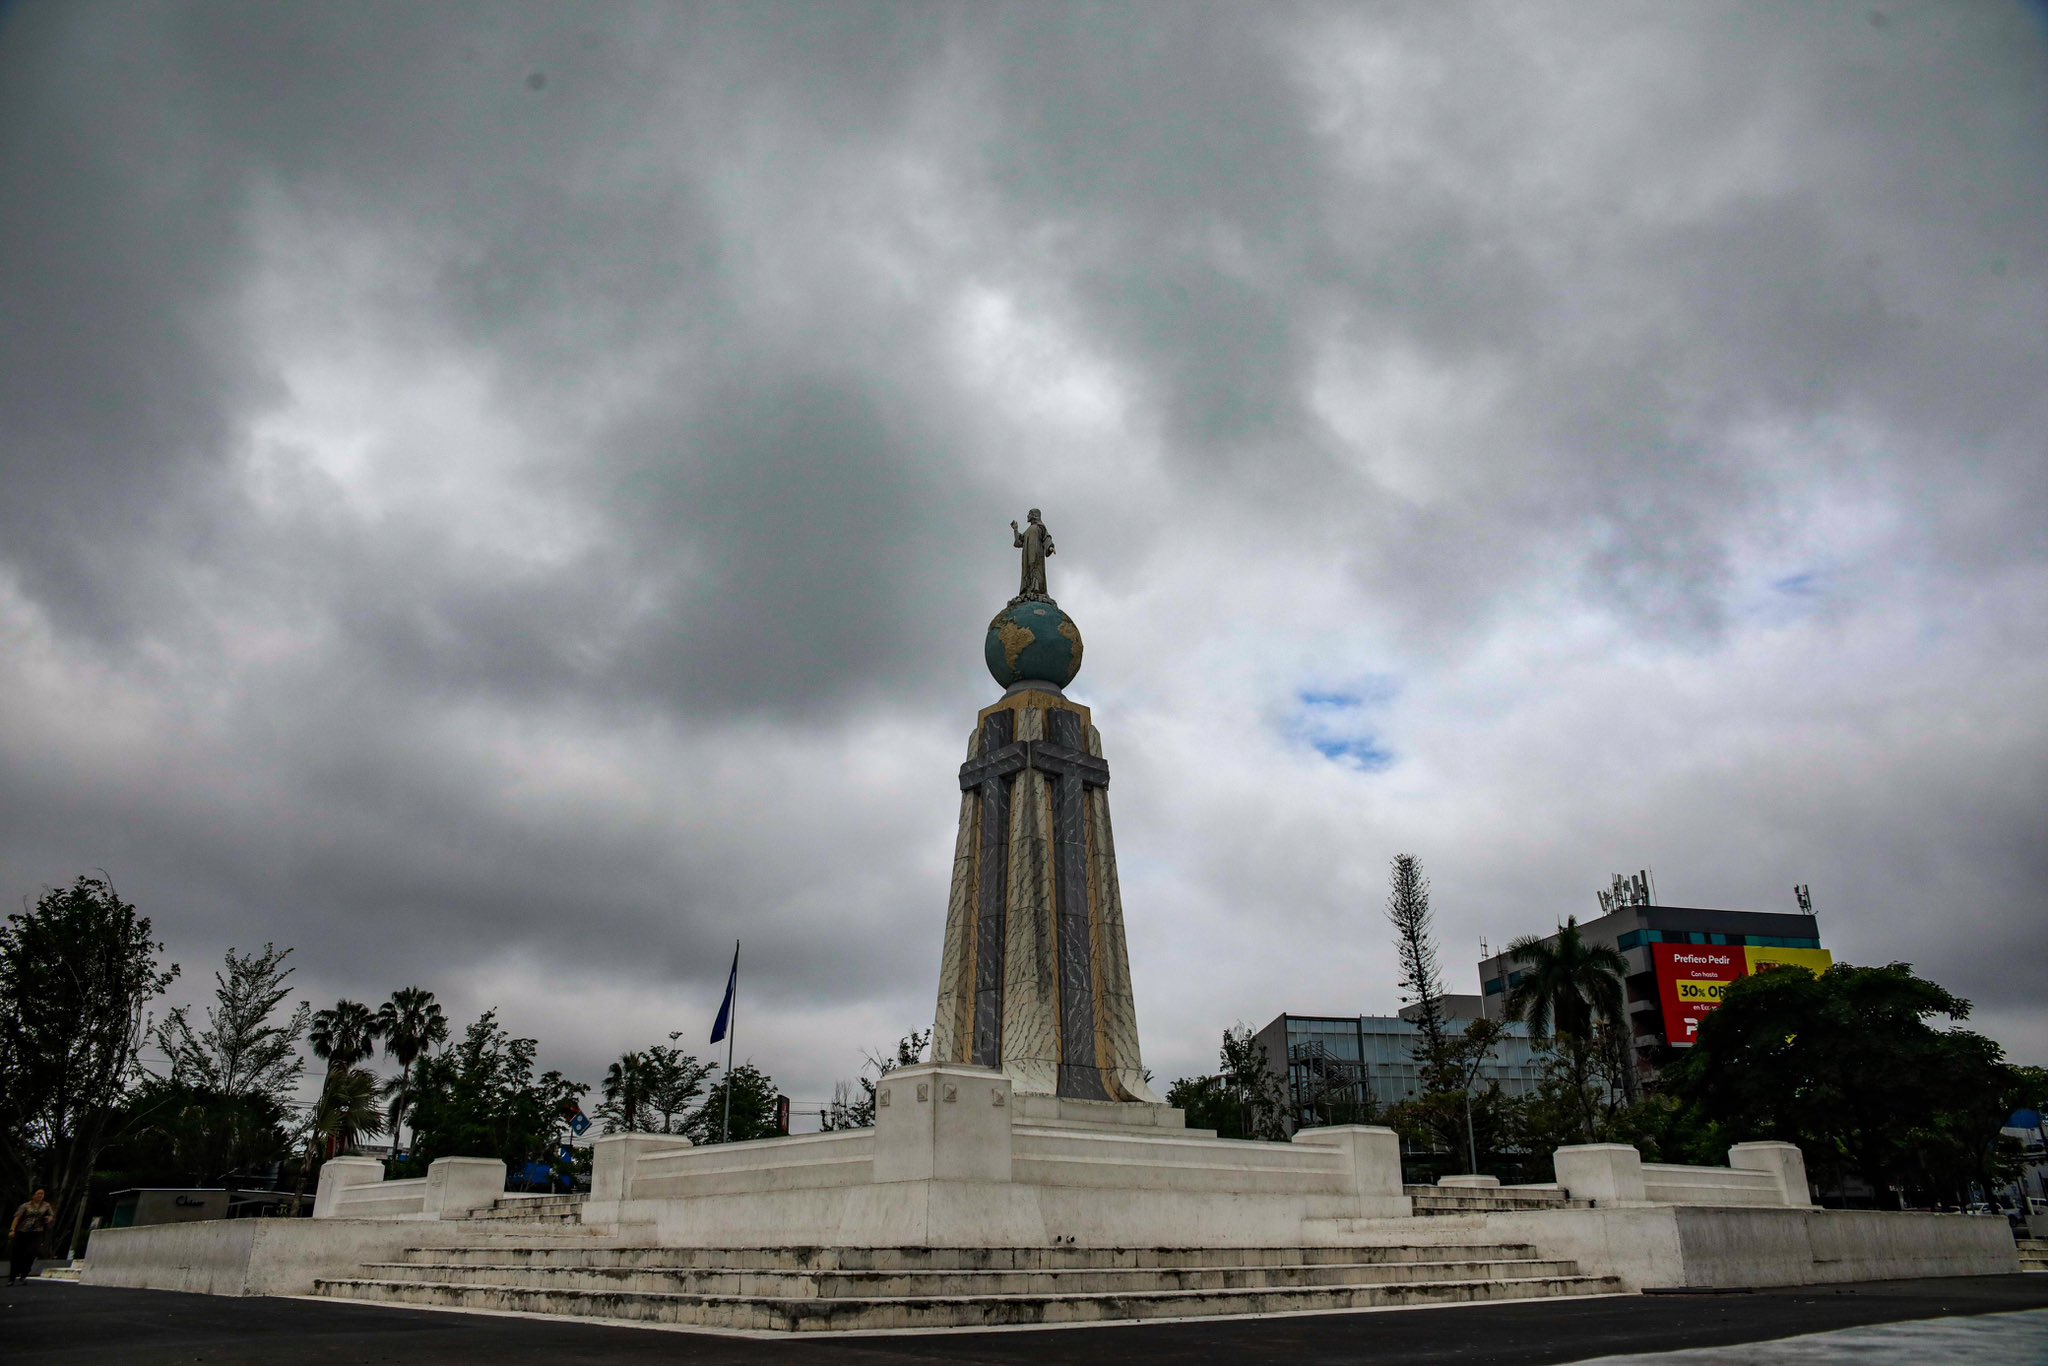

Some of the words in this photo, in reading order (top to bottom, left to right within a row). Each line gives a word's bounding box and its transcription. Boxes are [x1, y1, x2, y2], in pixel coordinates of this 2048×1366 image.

[1673, 953, 1707, 964] Prefiero
[1708, 955, 1730, 964] Pedir
[1681, 985, 1705, 997] 30%
